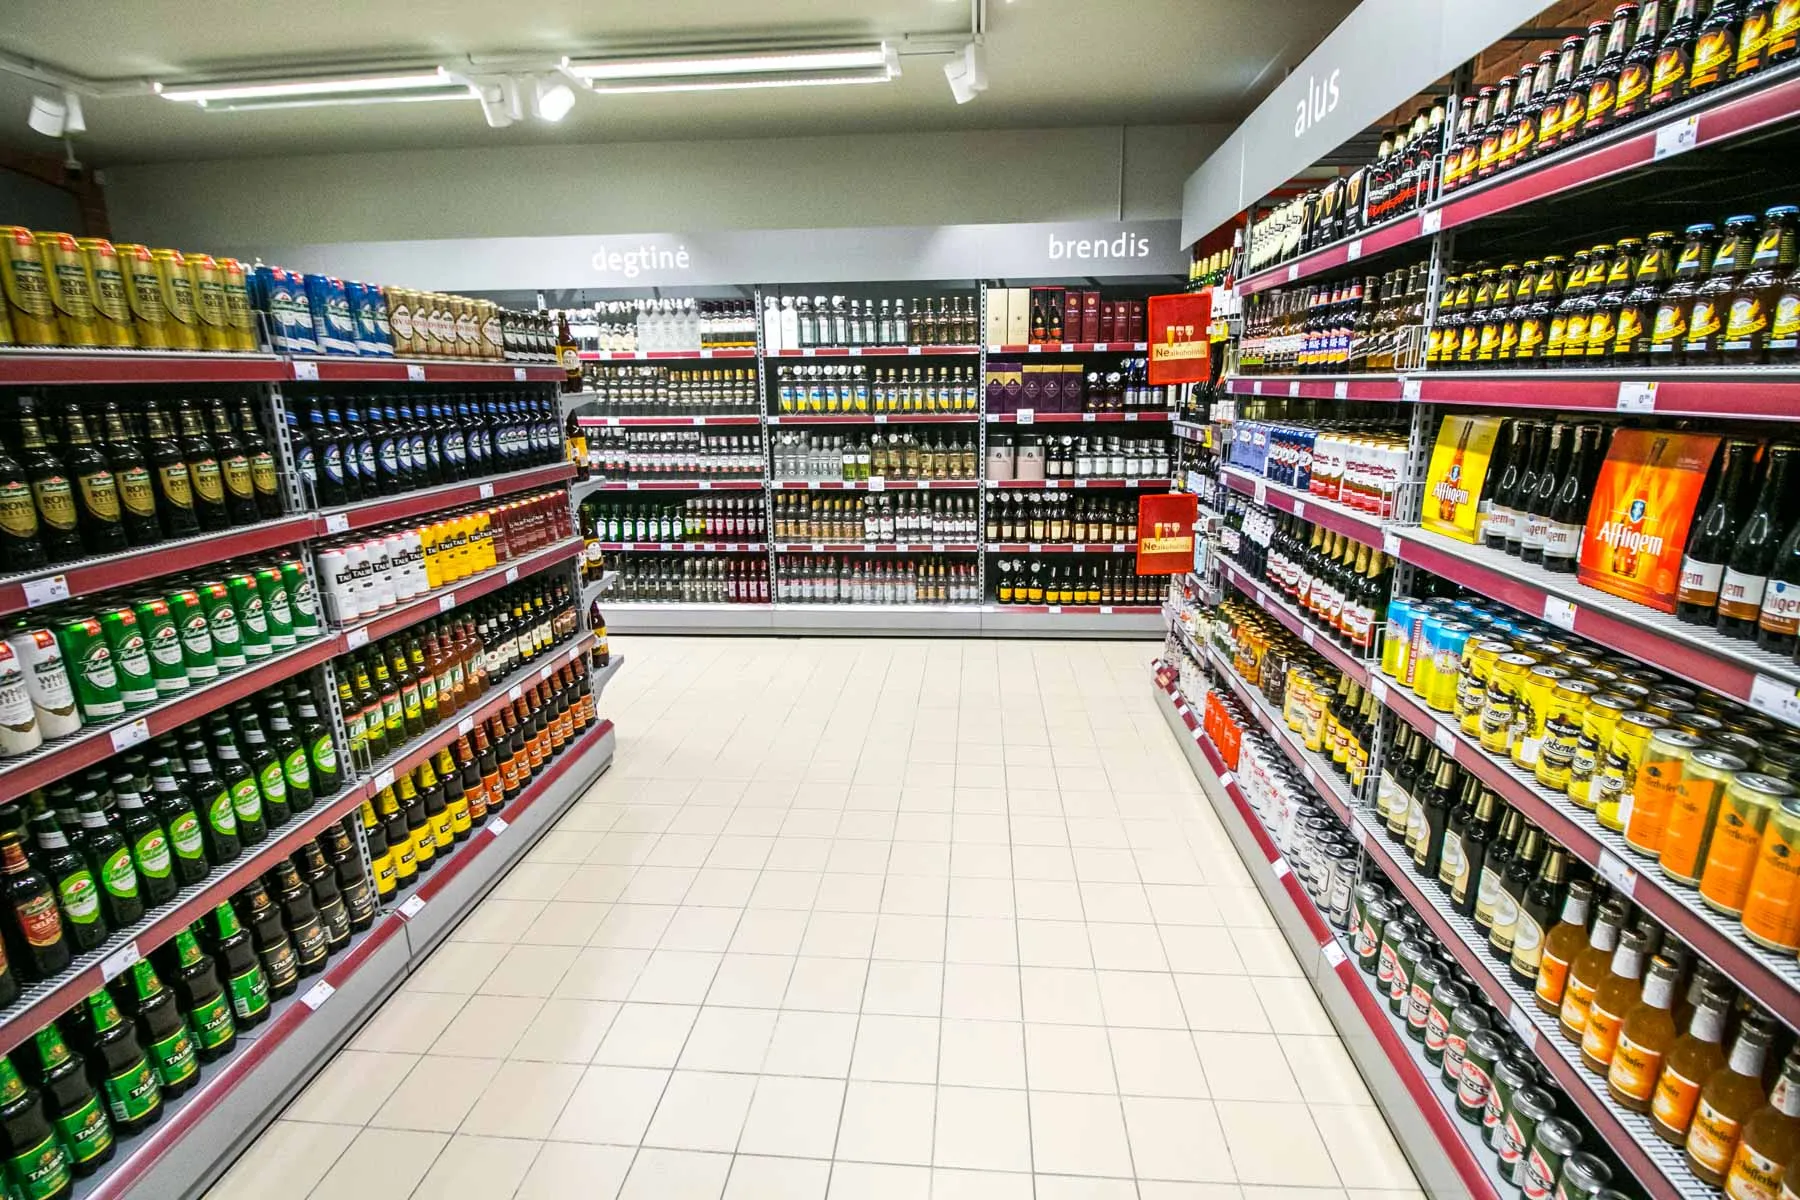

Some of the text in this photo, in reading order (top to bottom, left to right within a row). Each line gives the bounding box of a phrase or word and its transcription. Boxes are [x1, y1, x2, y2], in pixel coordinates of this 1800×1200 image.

[1294, 67, 1341, 138] alus
[591, 244, 690, 278] degtinė
[1048, 232, 1150, 259] brendis
[1432, 482, 1469, 505] Affligem
[1597, 521, 1664, 557] Affligem
